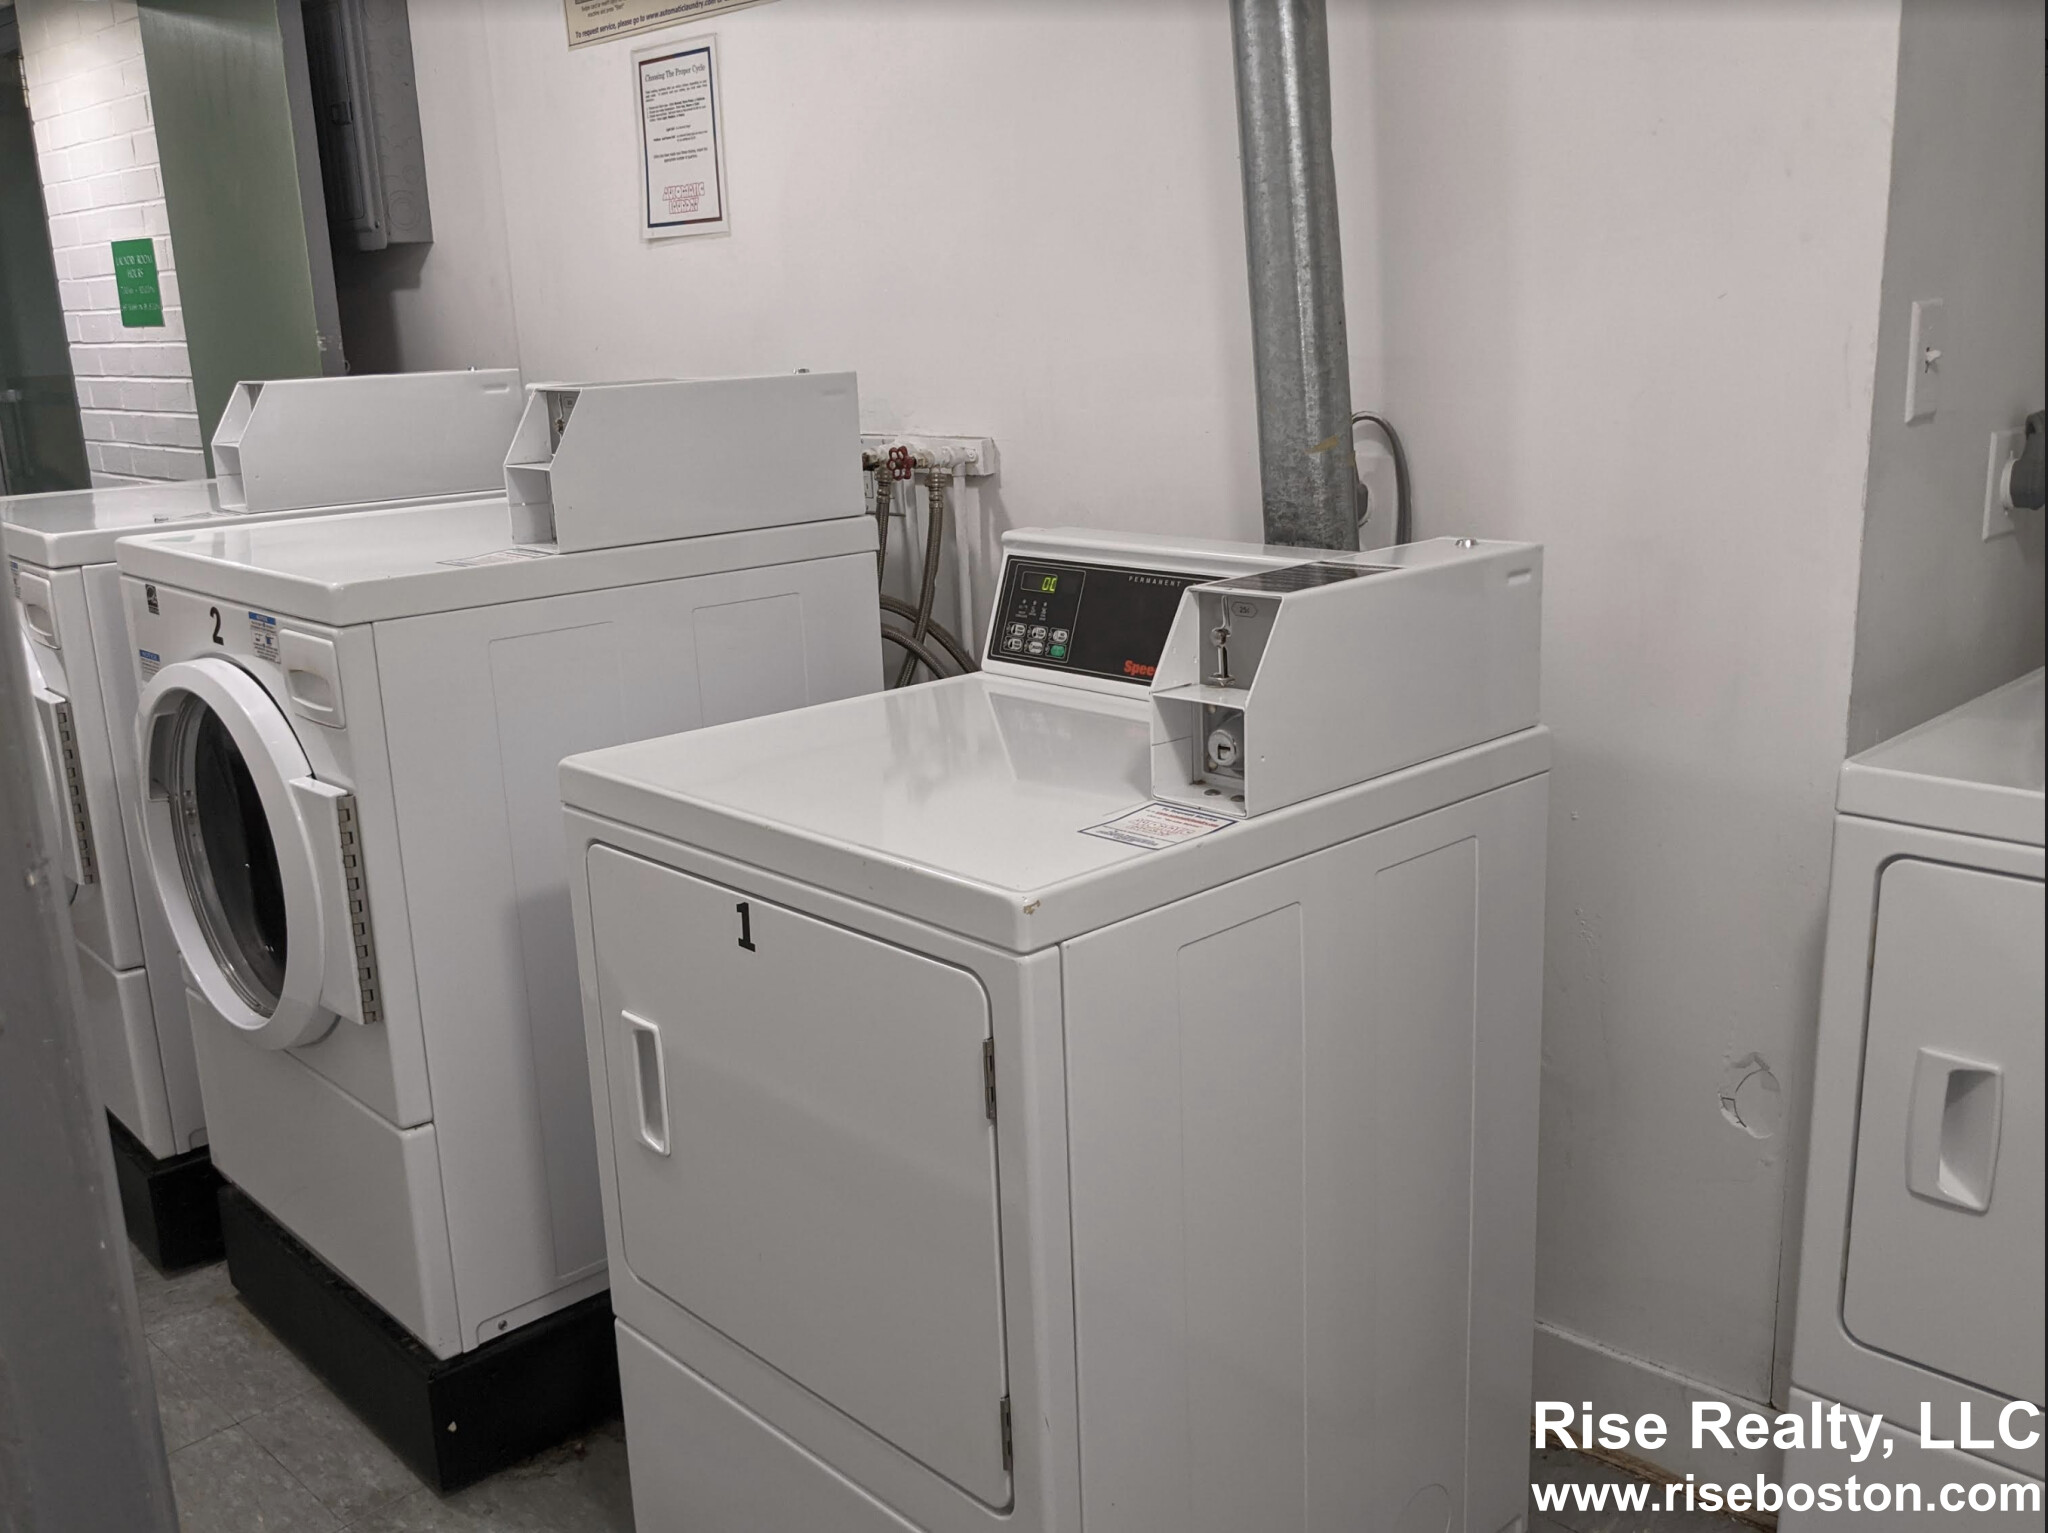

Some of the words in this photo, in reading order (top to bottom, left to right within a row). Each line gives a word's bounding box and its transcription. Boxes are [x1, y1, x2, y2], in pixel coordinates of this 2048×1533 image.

[582, 26, 599, 38] request
[599, 22, 617, 33] service,
[617, 18, 632, 29] please
[632, 16, 640, 26] go
[645, 73, 665, 82] Choosing
[665, 69, 675, 78] The
[675, 67, 691, 77] Proper
[691, 64, 706, 74] Cycle
[1128, 575, 1182, 588] PERMANENT
[210, 606, 224, 646] 2
[736, 902, 756, 952] 1
